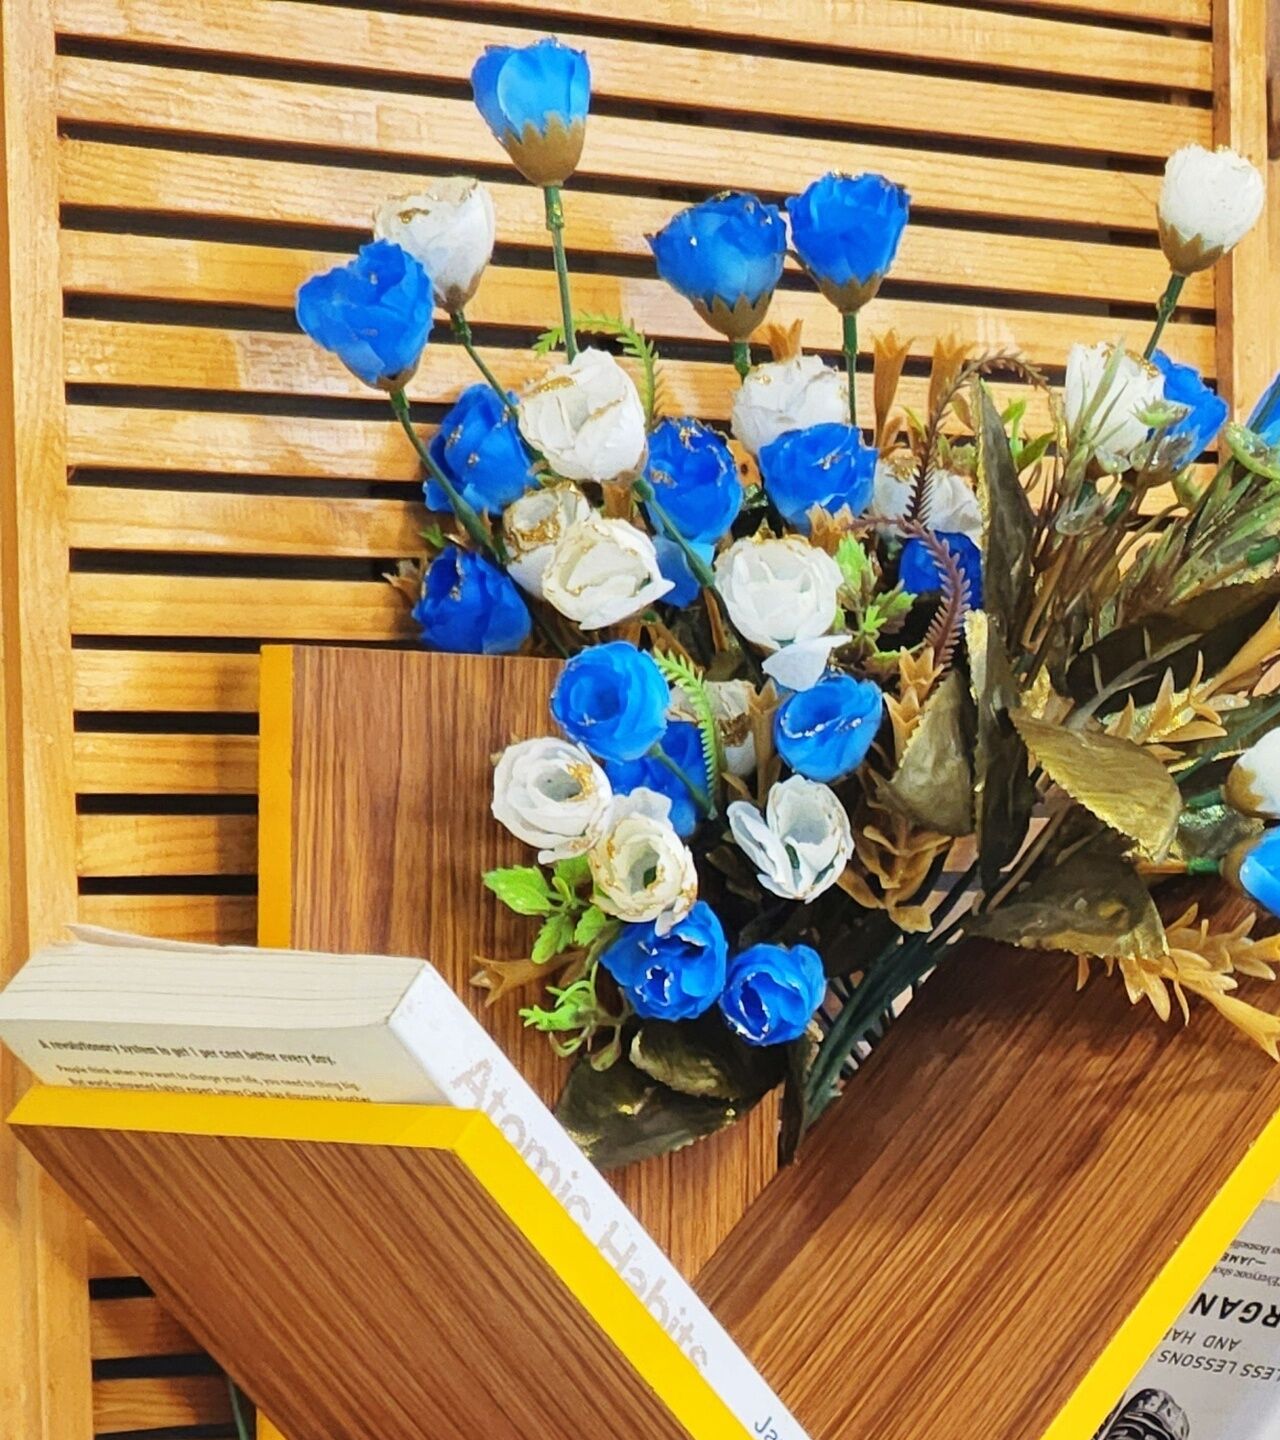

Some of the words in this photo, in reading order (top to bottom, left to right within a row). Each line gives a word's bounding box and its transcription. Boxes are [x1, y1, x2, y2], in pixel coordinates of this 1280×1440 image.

[279, 1053, 312, 1067] every
[451, 1058, 592, 1223] Atomic
[598, 1220, 708, 1368] Habits
[1203, 1335, 1242, 1352] AND
[1157, 1350, 1237, 1374] LESSONS
